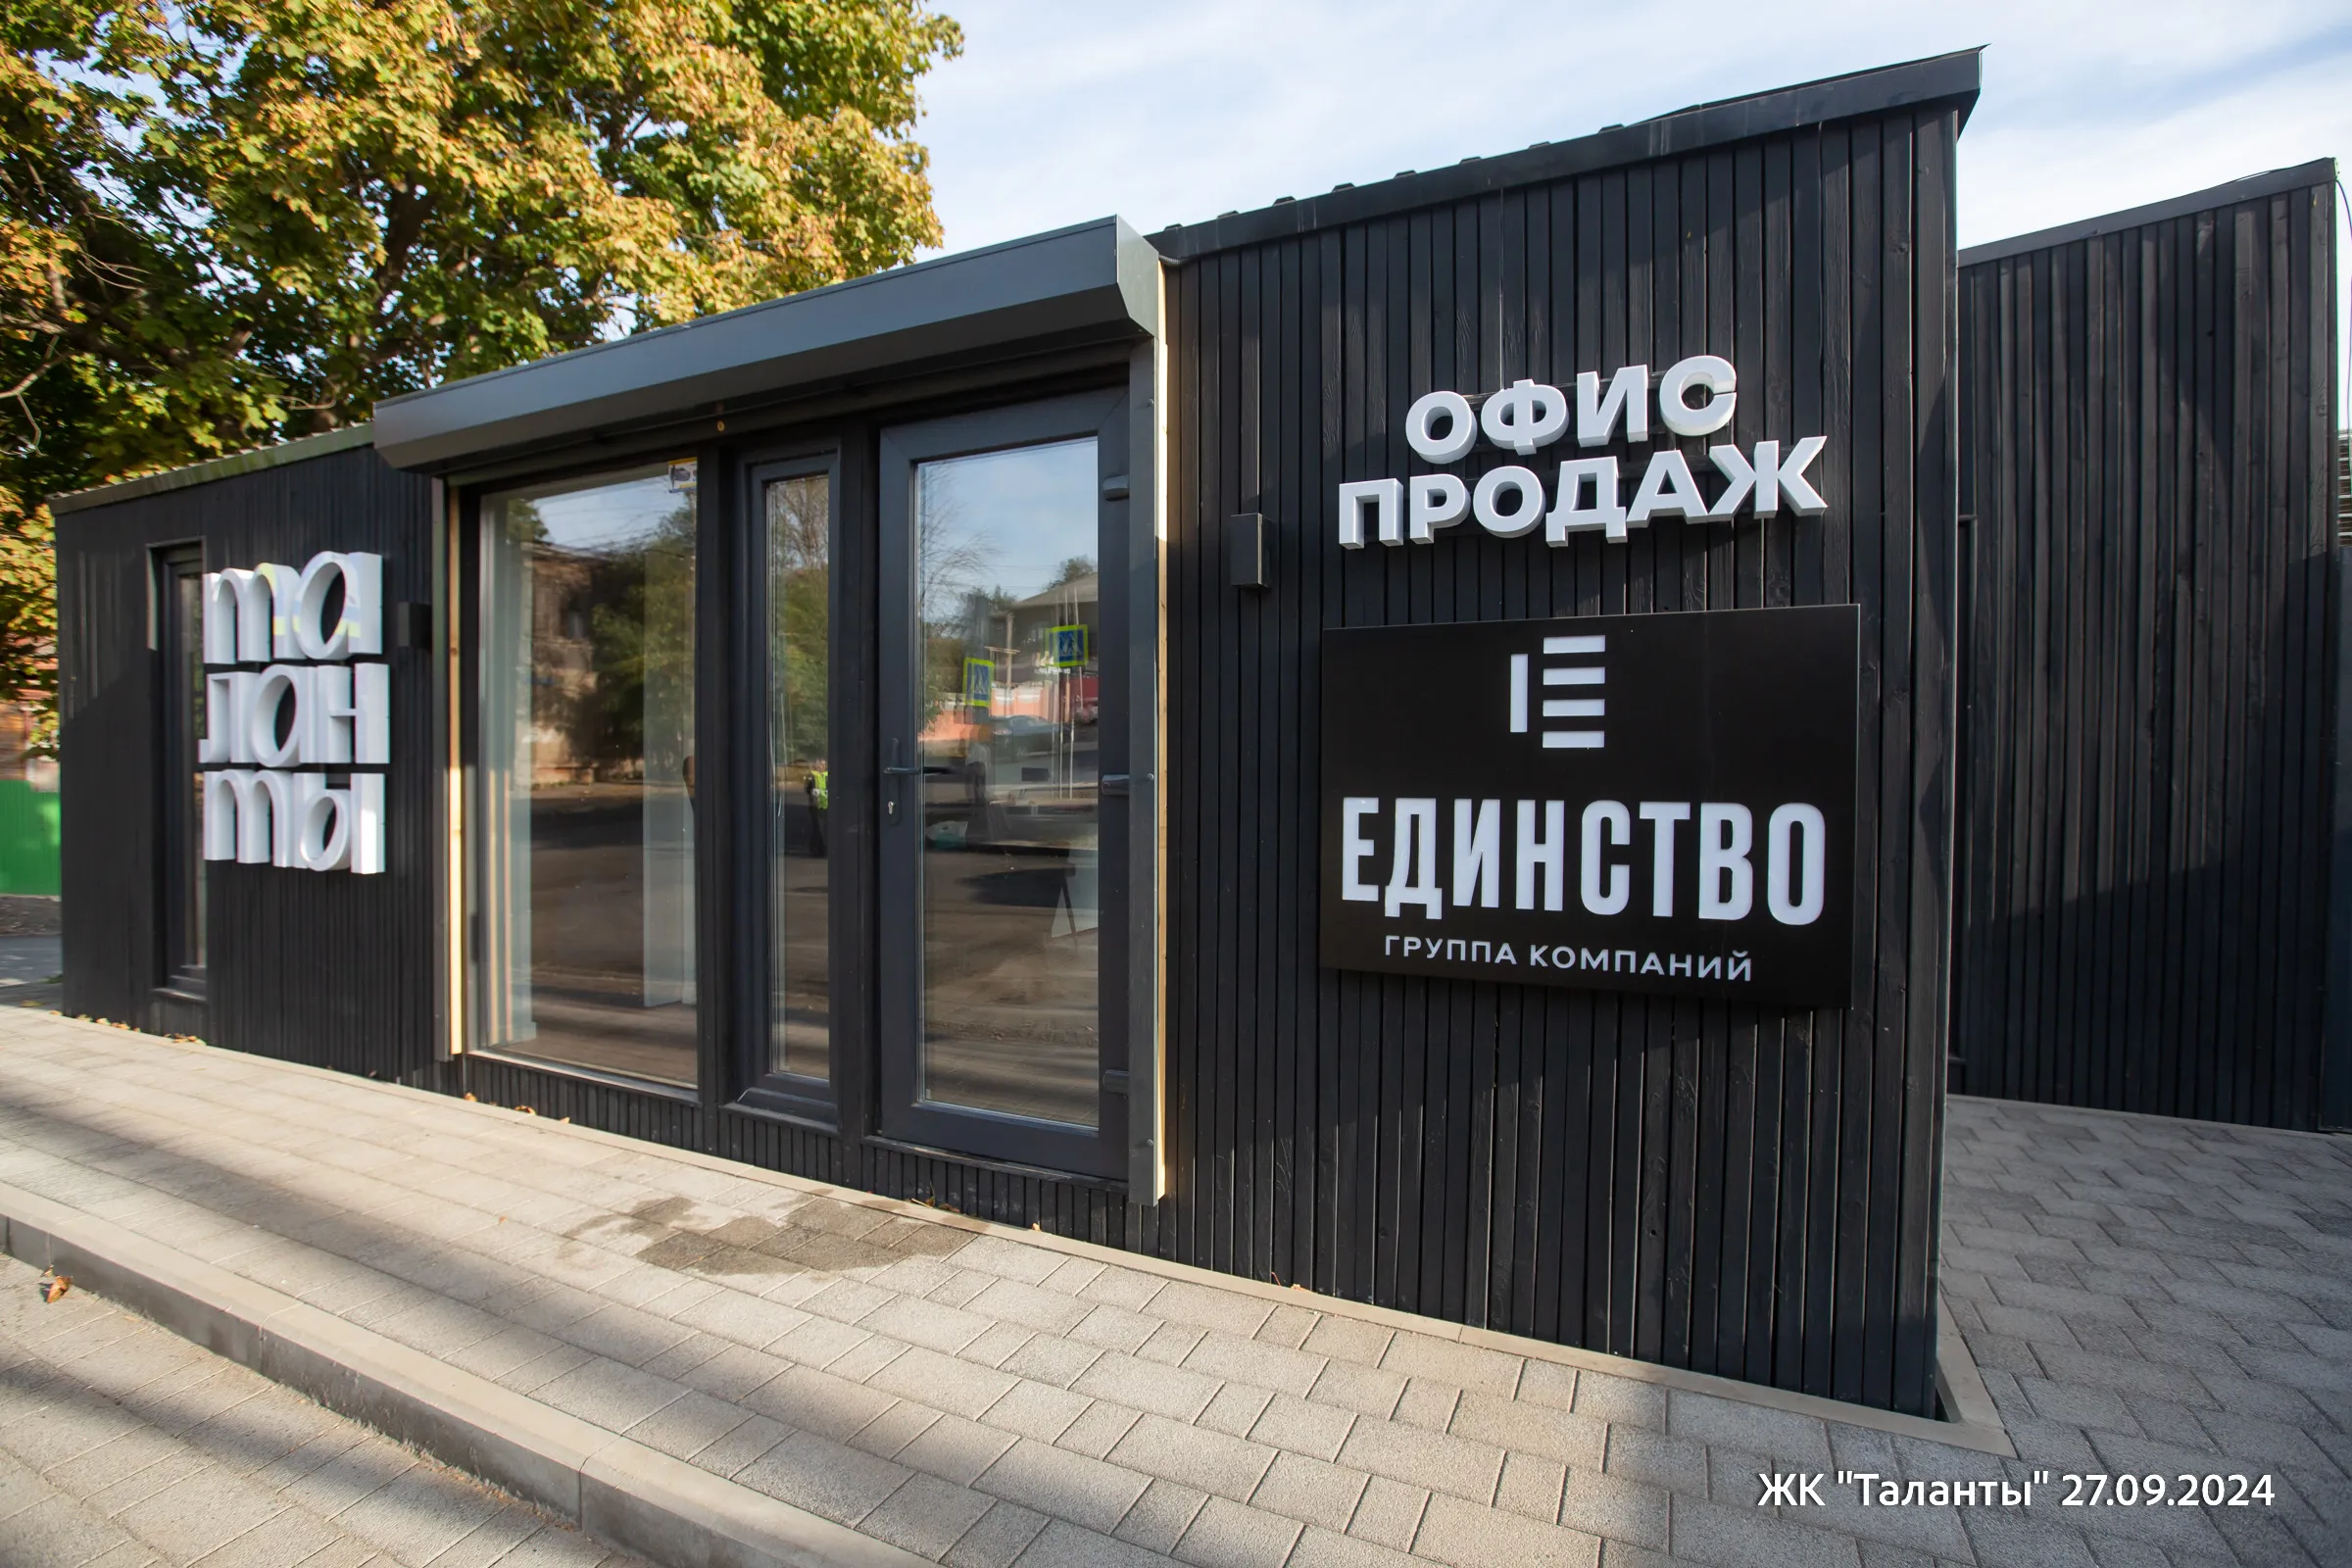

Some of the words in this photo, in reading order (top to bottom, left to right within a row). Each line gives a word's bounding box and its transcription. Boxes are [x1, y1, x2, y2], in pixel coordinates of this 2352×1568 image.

[1405, 355, 1738, 465] ОФИС
[1338, 435, 1829, 550] ПРОДАЖ
[1341, 796, 1827, 926] ЕДИНСТВО
[1384, 934, 1518, 965] ГРУППА
[1529, 943, 1753, 982] КОМПАНИЙ
